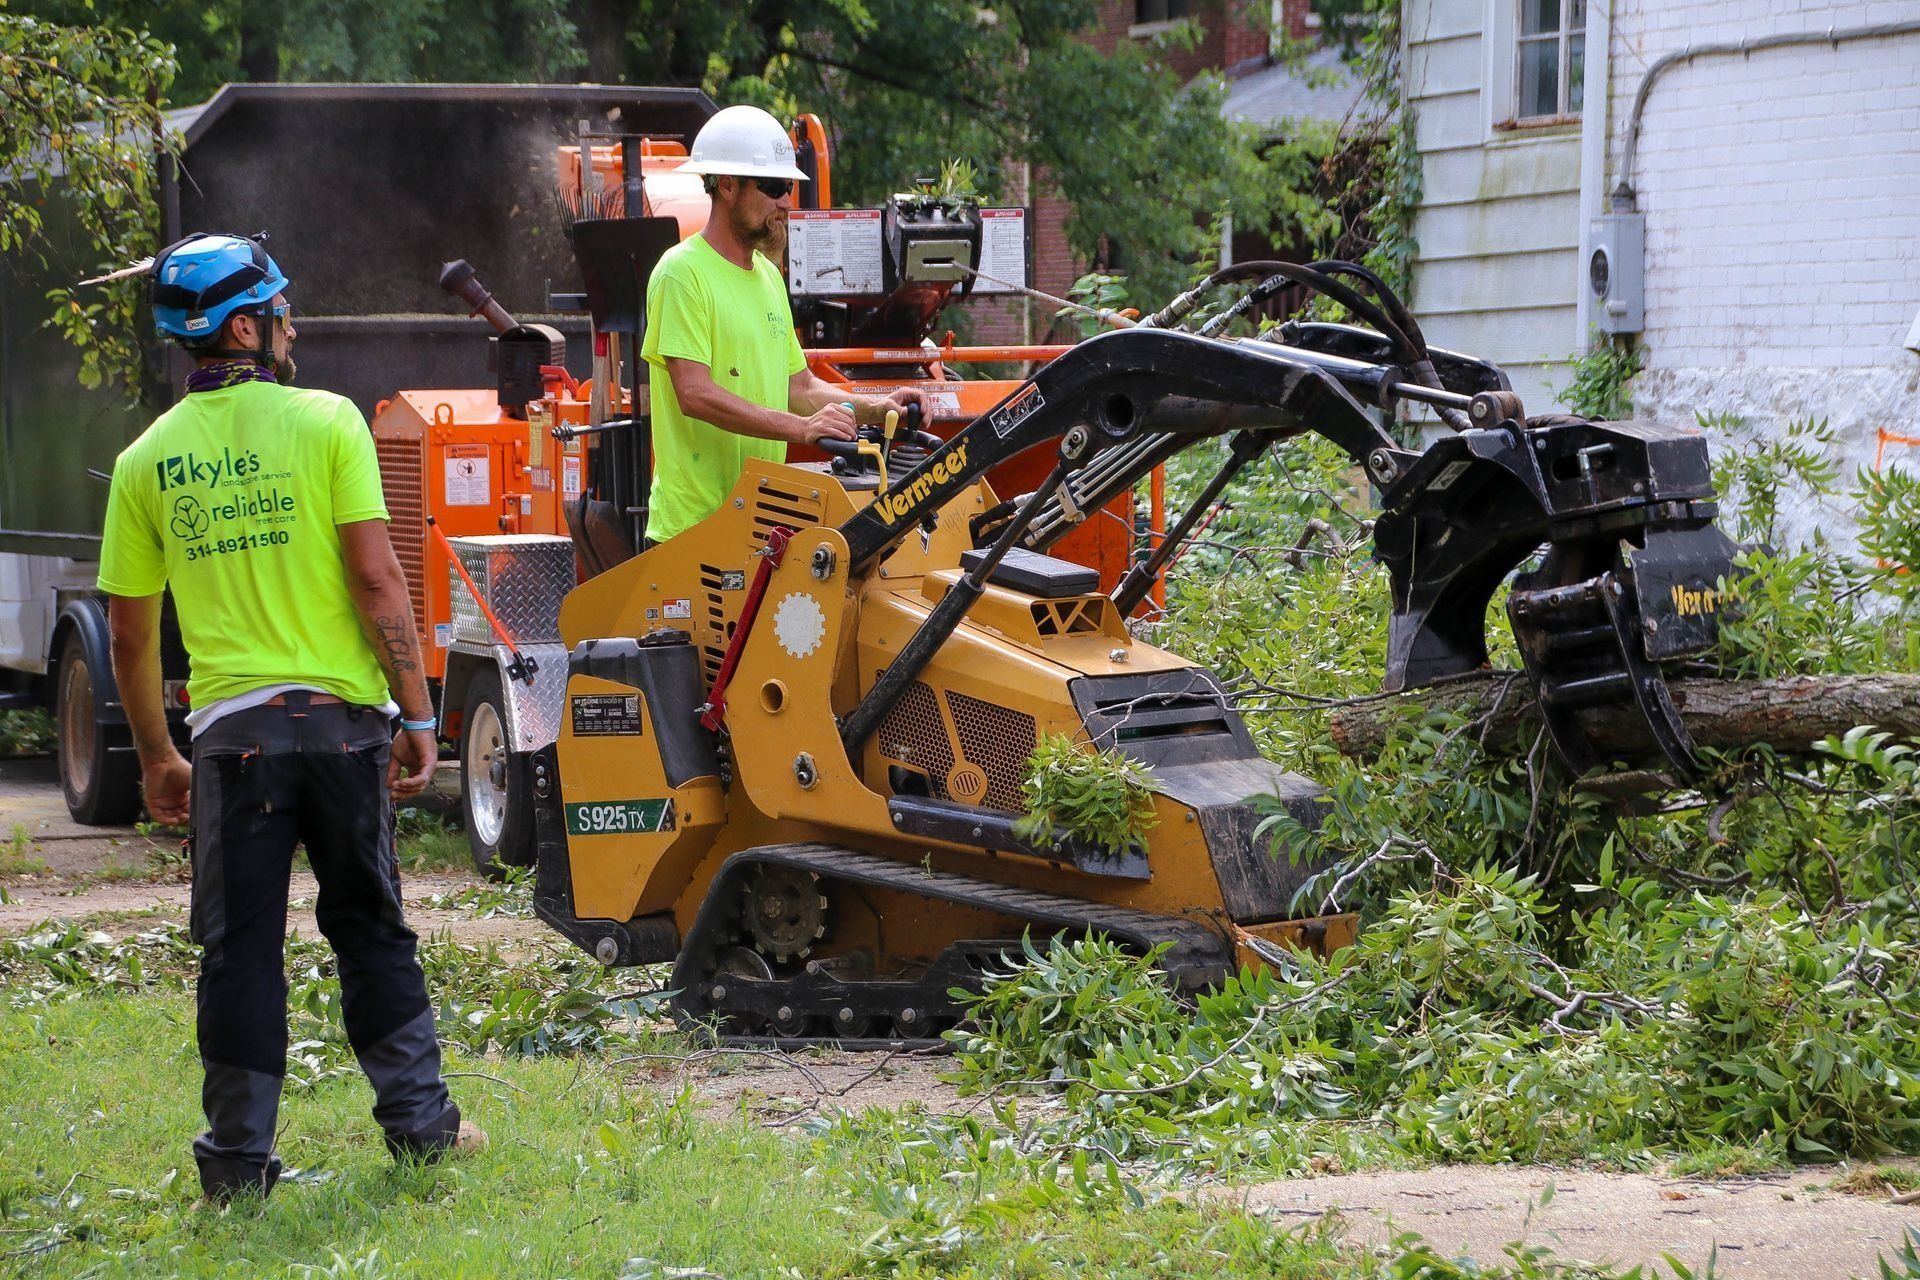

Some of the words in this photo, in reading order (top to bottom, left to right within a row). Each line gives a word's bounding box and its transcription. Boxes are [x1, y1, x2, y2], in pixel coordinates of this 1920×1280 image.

[188, 447, 260, 488] kyle's
[261, 471, 292, 480] service
[873, 443, 968, 526] Vermeer
[212, 488, 295, 521] reliable
[274, 514, 297, 523] care
[185, 531, 290, 561] 314-8921500
